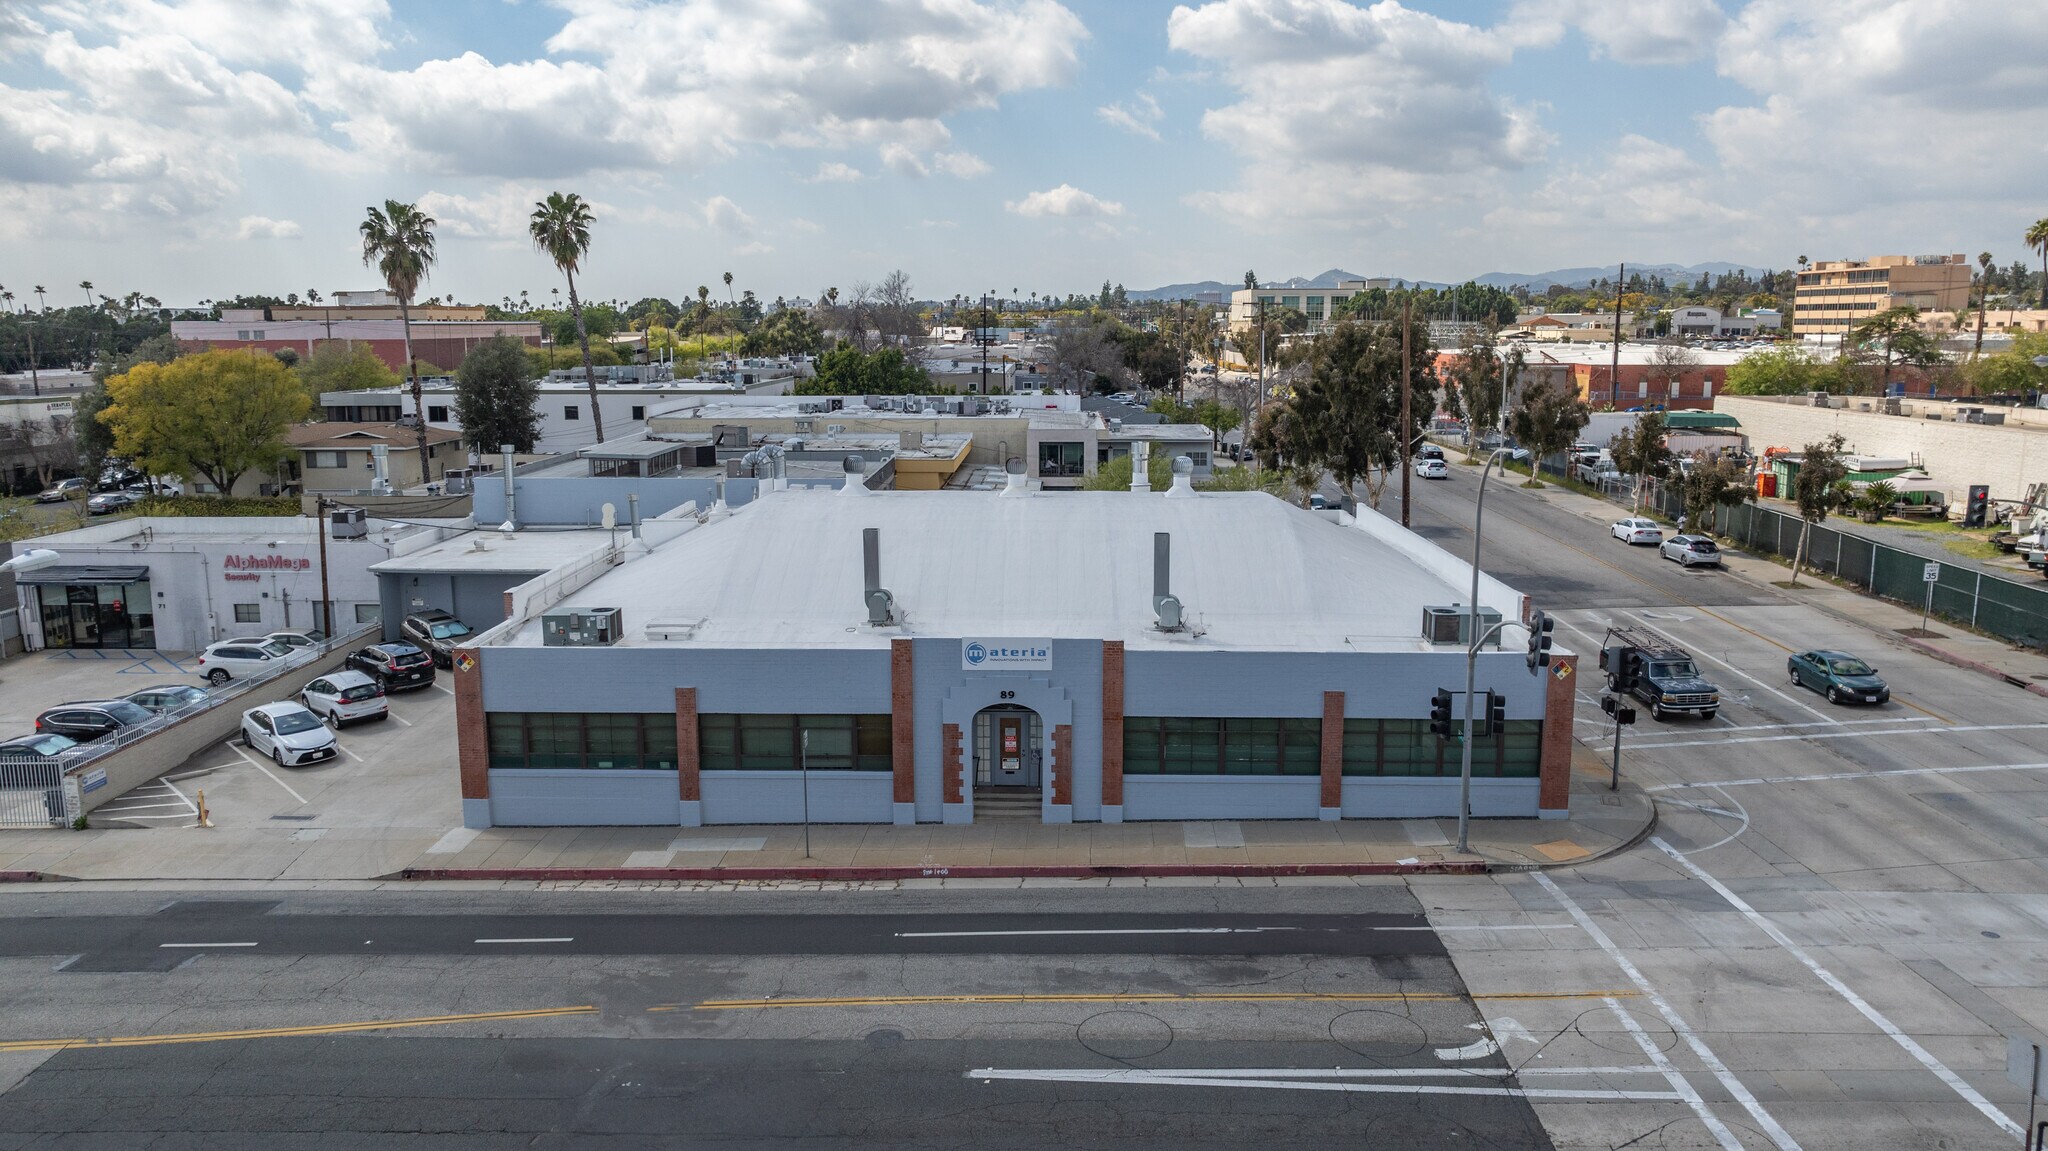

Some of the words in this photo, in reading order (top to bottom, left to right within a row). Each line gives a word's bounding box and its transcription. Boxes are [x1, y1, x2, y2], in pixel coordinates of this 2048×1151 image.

[224, 555, 310, 571] AlphaMega
[224, 573, 260, 582] Security
[1000, 691, 1015, 699] 89
